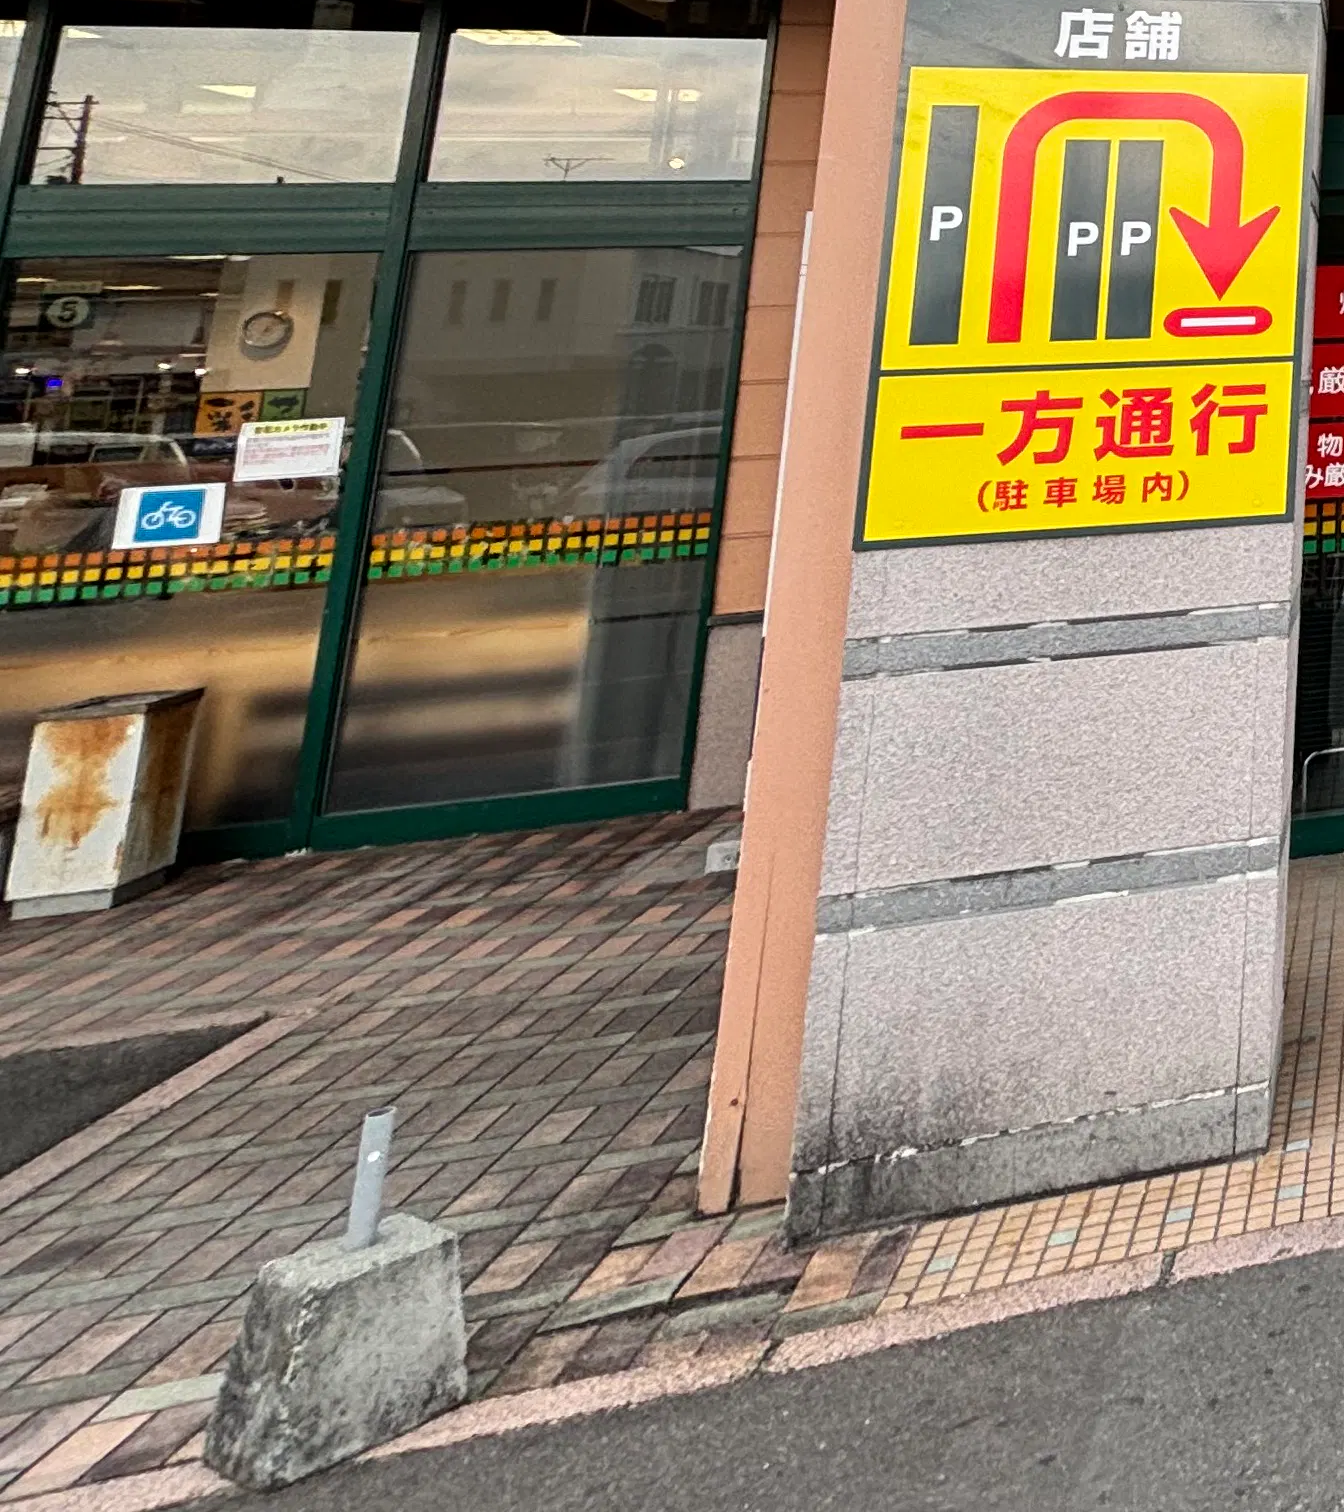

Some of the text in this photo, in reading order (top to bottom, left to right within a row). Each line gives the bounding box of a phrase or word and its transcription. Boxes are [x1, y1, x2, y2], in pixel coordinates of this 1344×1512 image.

[1054, 7, 1183, 61] 店舗
[929, 205, 964, 241] P
[1067, 220, 1152, 257] P P
[900, 383, 1269, 466] 一方通行
